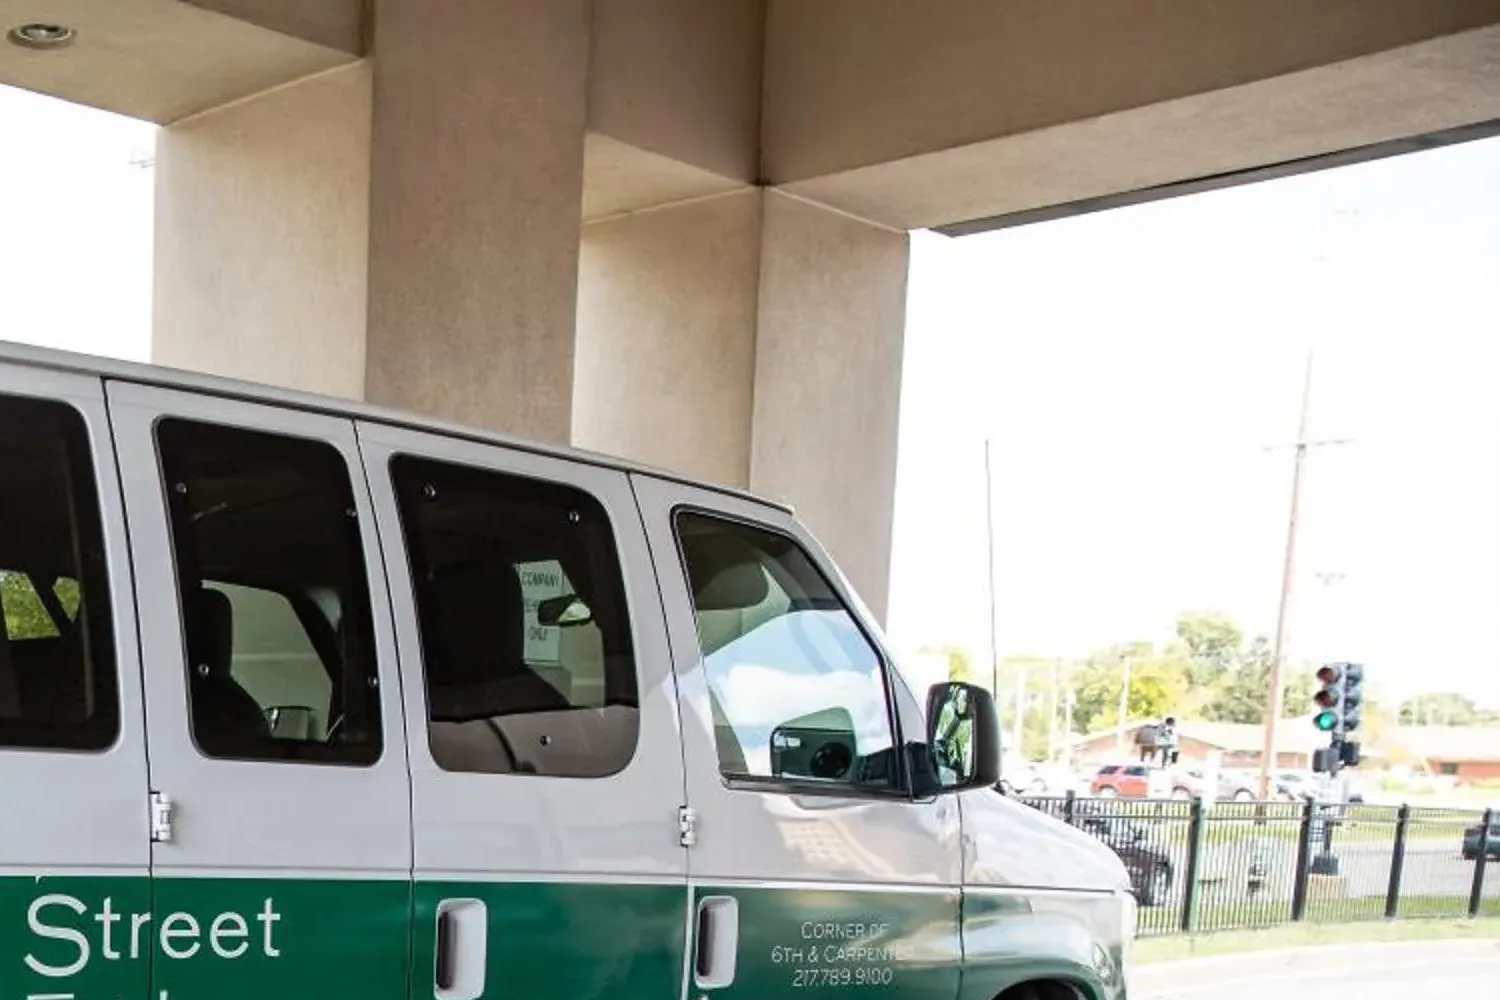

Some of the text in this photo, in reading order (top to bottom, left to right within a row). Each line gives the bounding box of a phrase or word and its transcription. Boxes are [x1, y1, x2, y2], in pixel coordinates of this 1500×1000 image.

[24, 893, 281, 977] Street
[801, 921, 866, 939] CORNER
[771, 945, 914, 963] 6TH & CARPENT
[792, 966, 893, 988] 217.789.9100
